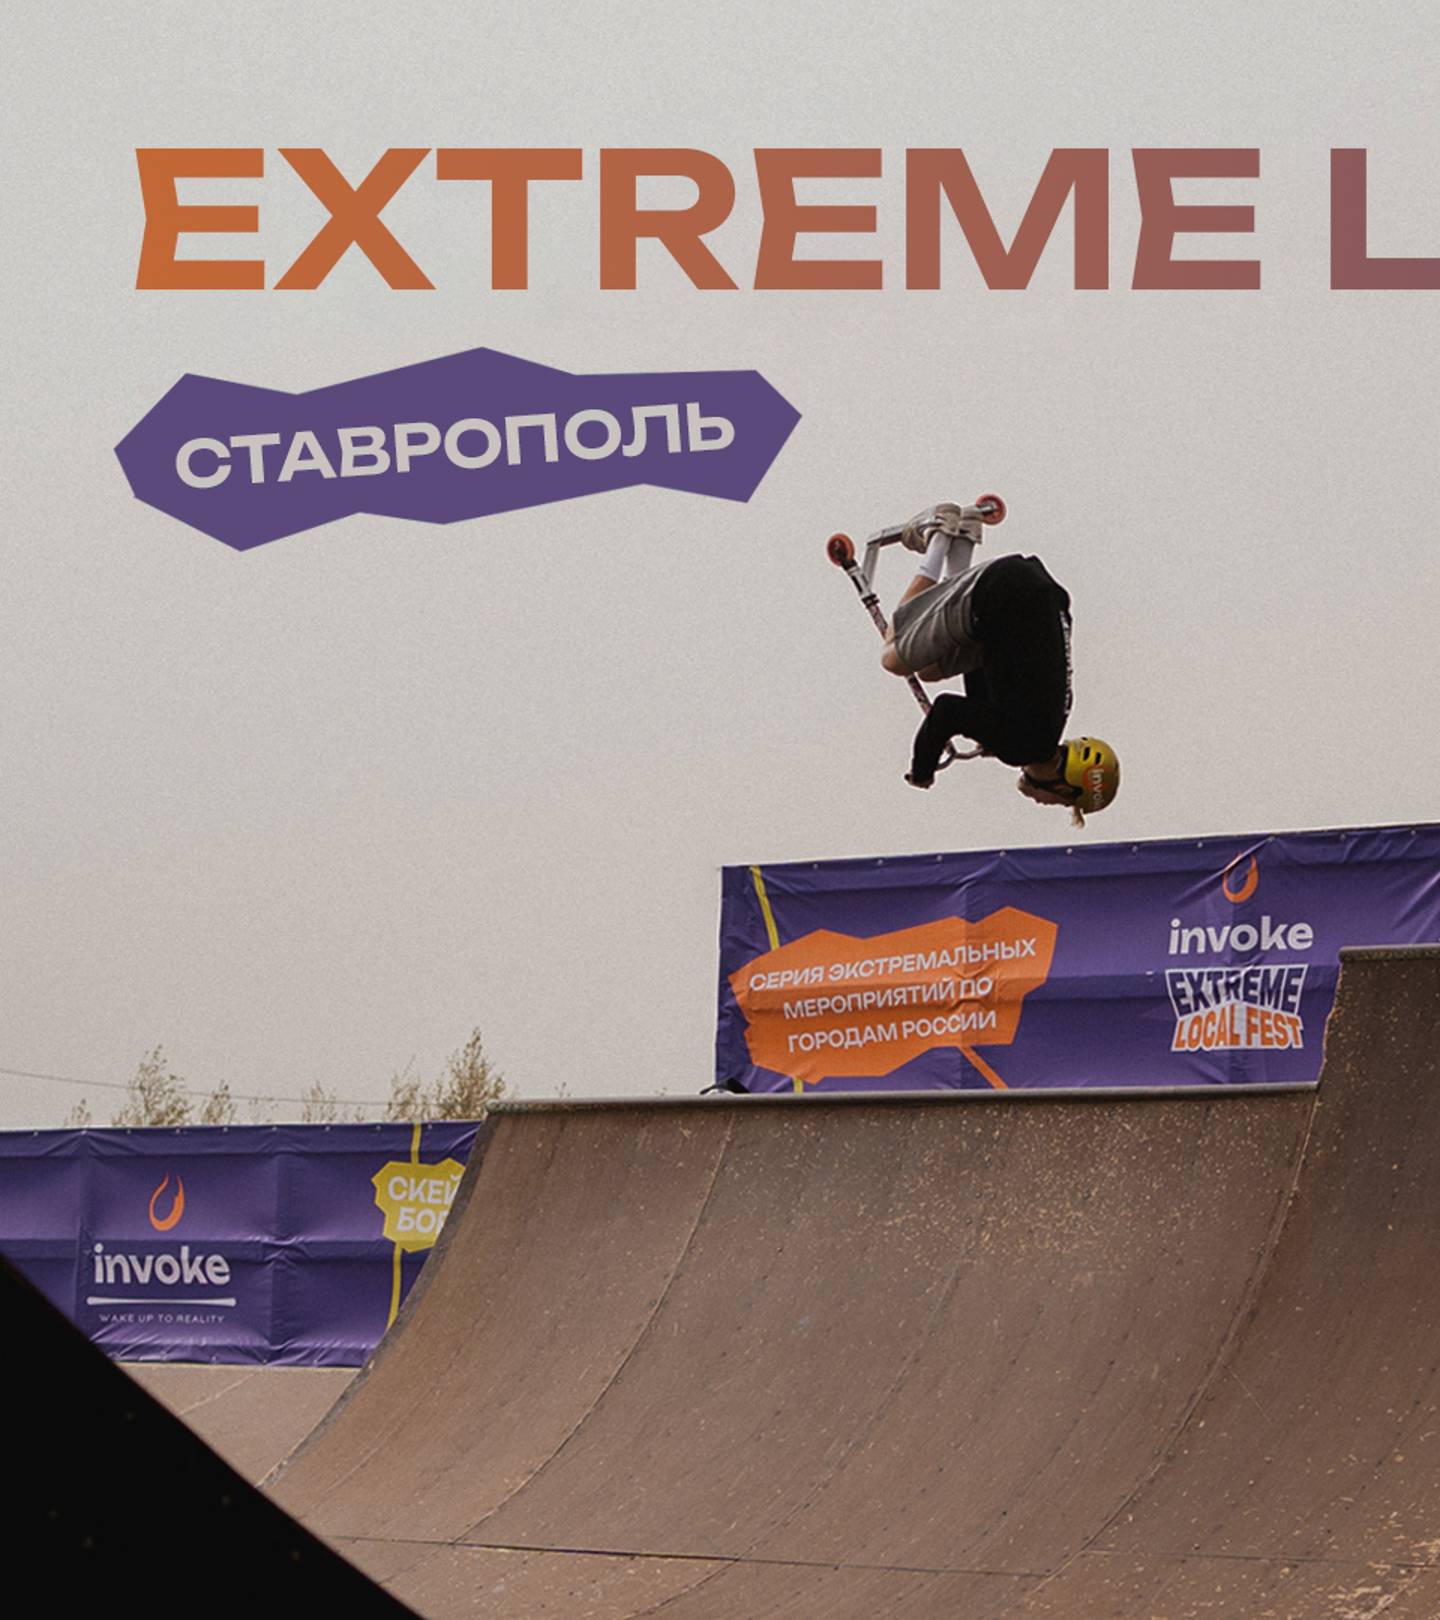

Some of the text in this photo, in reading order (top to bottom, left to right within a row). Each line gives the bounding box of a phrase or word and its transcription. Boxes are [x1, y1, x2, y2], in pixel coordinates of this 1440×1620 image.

[1168, 915, 1314, 955] invoke
[749, 938, 1036, 992] СЕРИЯ ЭКСТРЕМАЛЬНЫХ
[782, 975, 993, 1020] МЕРОПРИЯТИЙ ПО
[1166, 965, 1307, 1018] EXTREME
[787, 1009, 997, 1052] ГОРОДАМ РОССИИ
[1174, 1003, 1301, 1049] LOCAL FEST
[94, 1243, 231, 1286] invoke
[99, 1313, 225, 1324] WAKE UP TO REALITY
